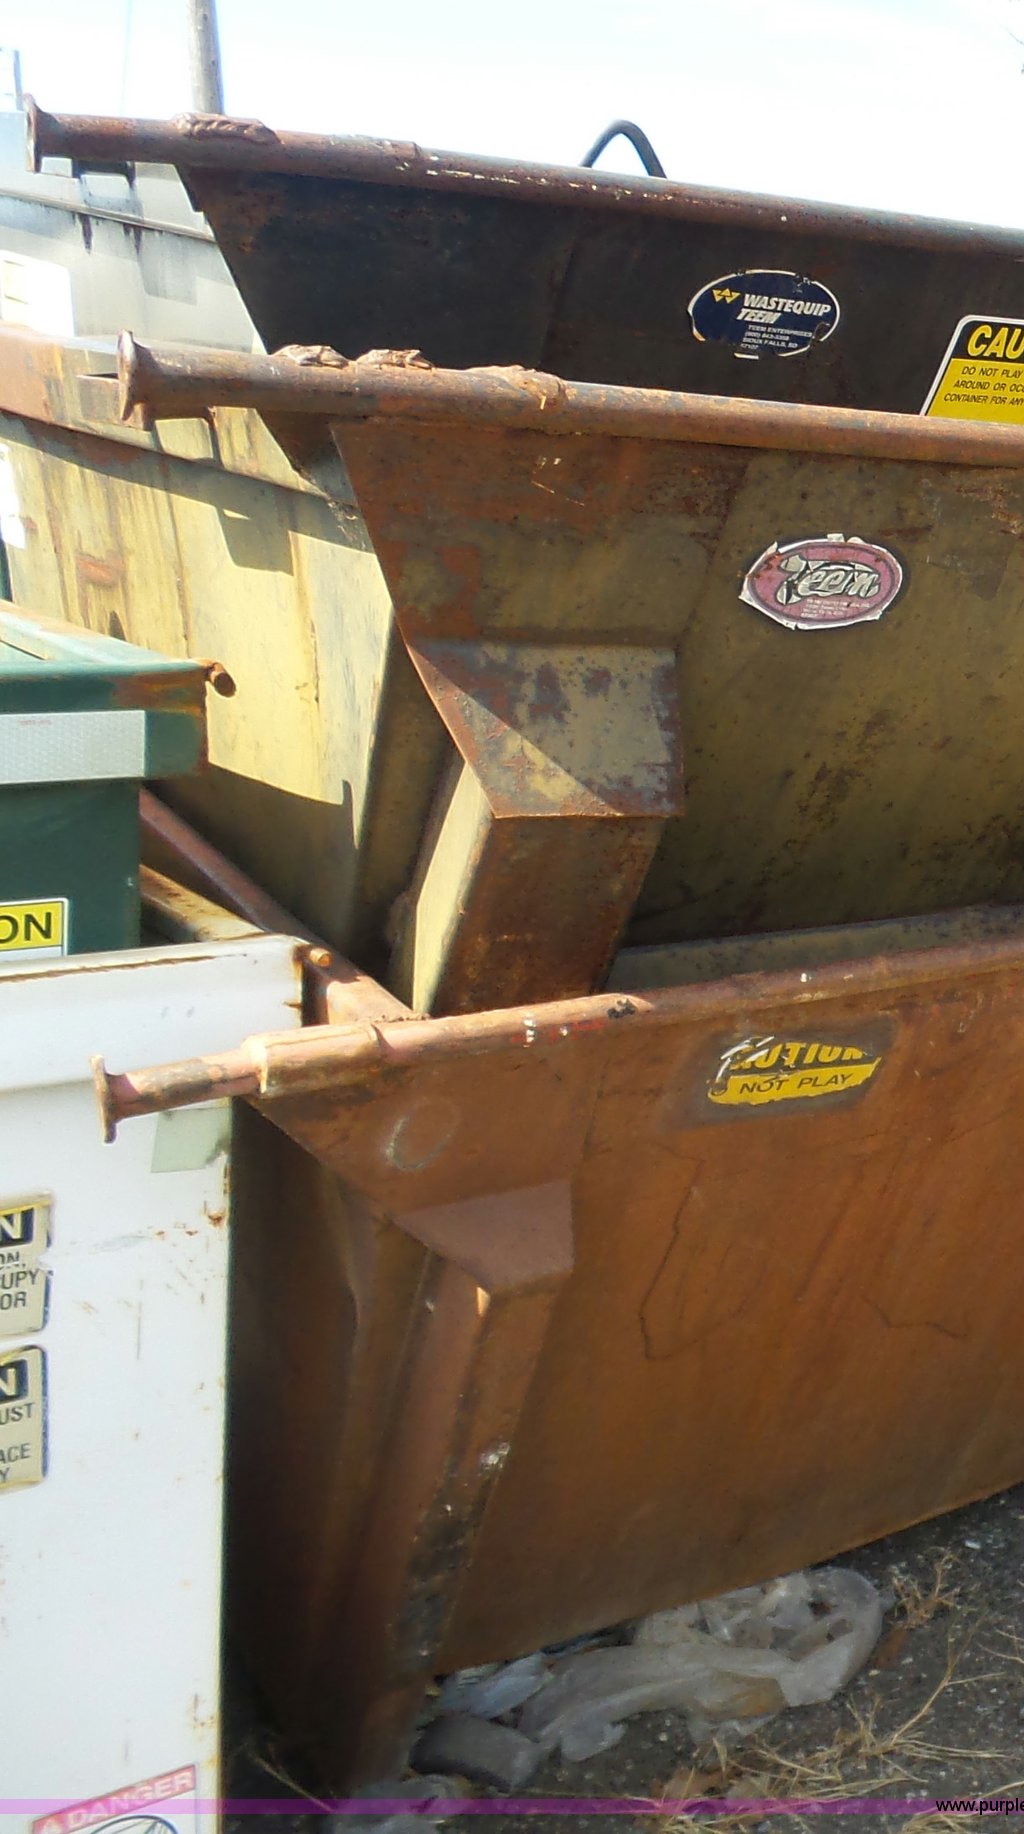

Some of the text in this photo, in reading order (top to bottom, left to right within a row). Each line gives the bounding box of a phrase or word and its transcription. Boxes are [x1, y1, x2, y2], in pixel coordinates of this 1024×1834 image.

[743, 293, 832, 317] WASTEQUIP
[736, 308, 783, 324] TEEM
[748, 324, 767, 332] TEEM
[961, 366, 976, 375] DO
[979, 367, 998, 377] NOT
[1001, 369, 1023, 379] PLAY
[954, 379, 990, 390] AROUND
[993, 382, 1007, 391] OR
[943, 393, 988, 404] CONTAINER
[989, 396, 1007, 405] FOR
[1009, 397, 1024, 406] ANY
[739, 1077, 790, 1094] NOT
[798, 1073, 853, 1089] PLAY
[69, 1771, 194, 1829] DANGER
